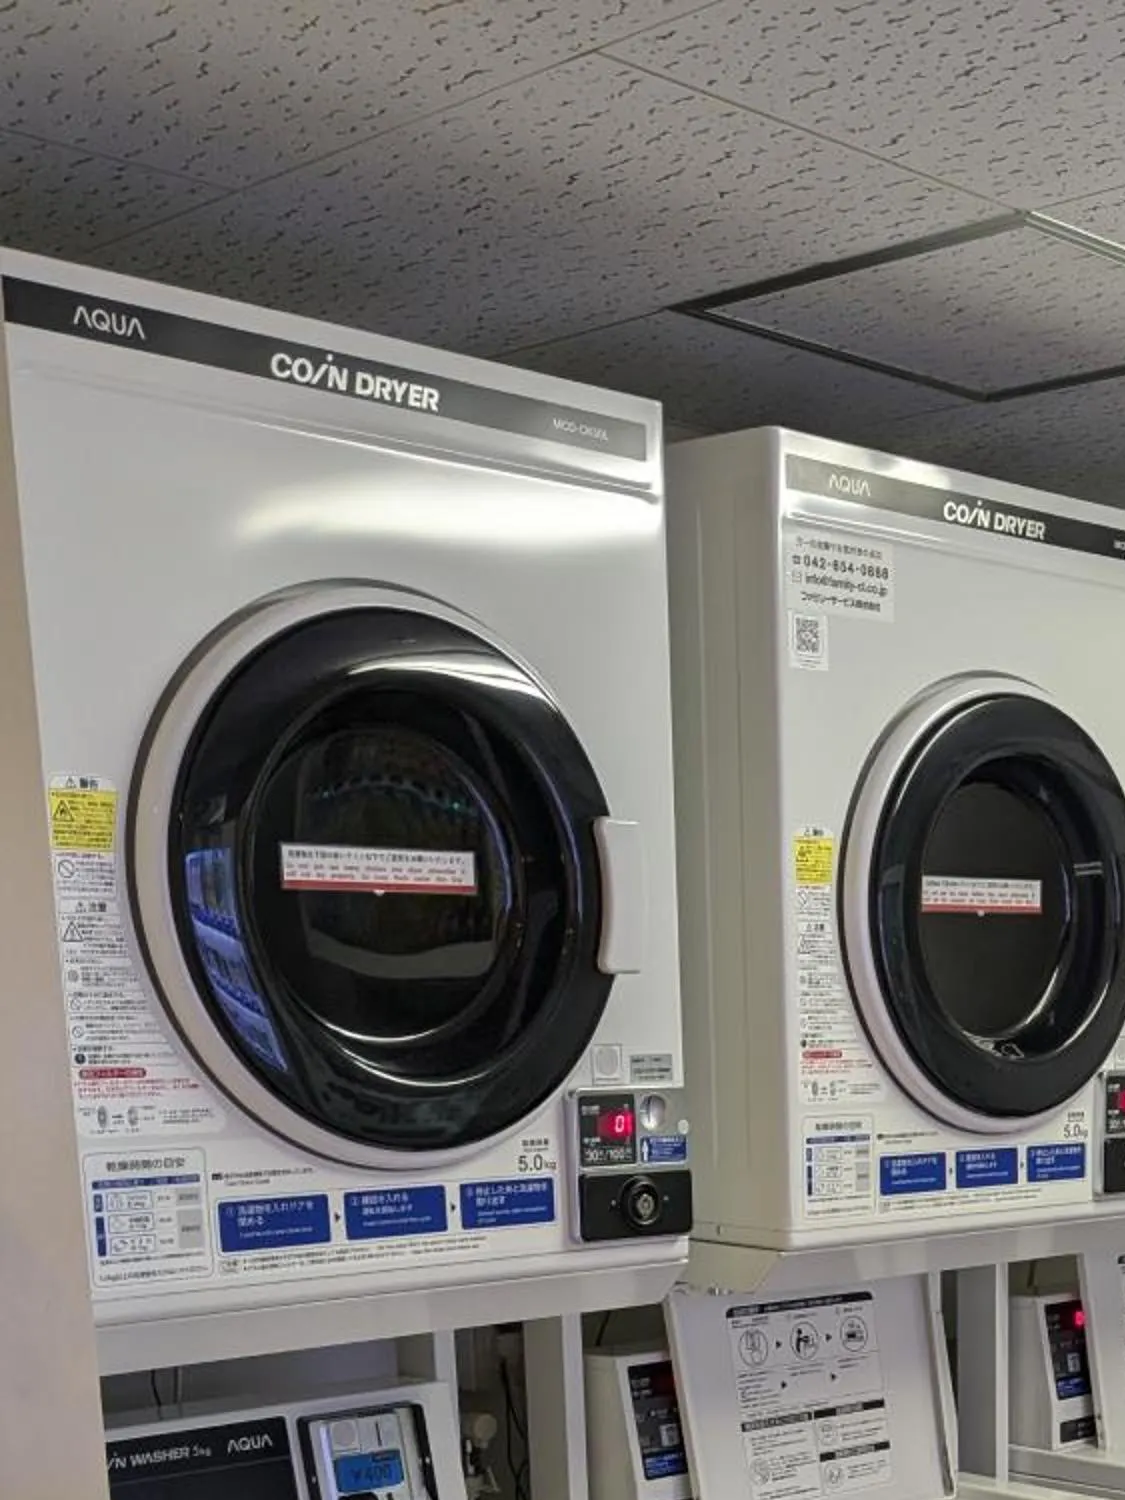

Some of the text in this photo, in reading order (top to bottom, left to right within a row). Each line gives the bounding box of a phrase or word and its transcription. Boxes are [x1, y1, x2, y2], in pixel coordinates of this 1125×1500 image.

[72, 306, 147, 341] AQUA
[355, 370, 441, 412] DRYER
[829, 473, 871, 497] AQUA
[994, 511, 1047, 540] DRYER
[130, 1446, 190, 1468] WASHER
[227, 1433, 273, 1454] AQUA
